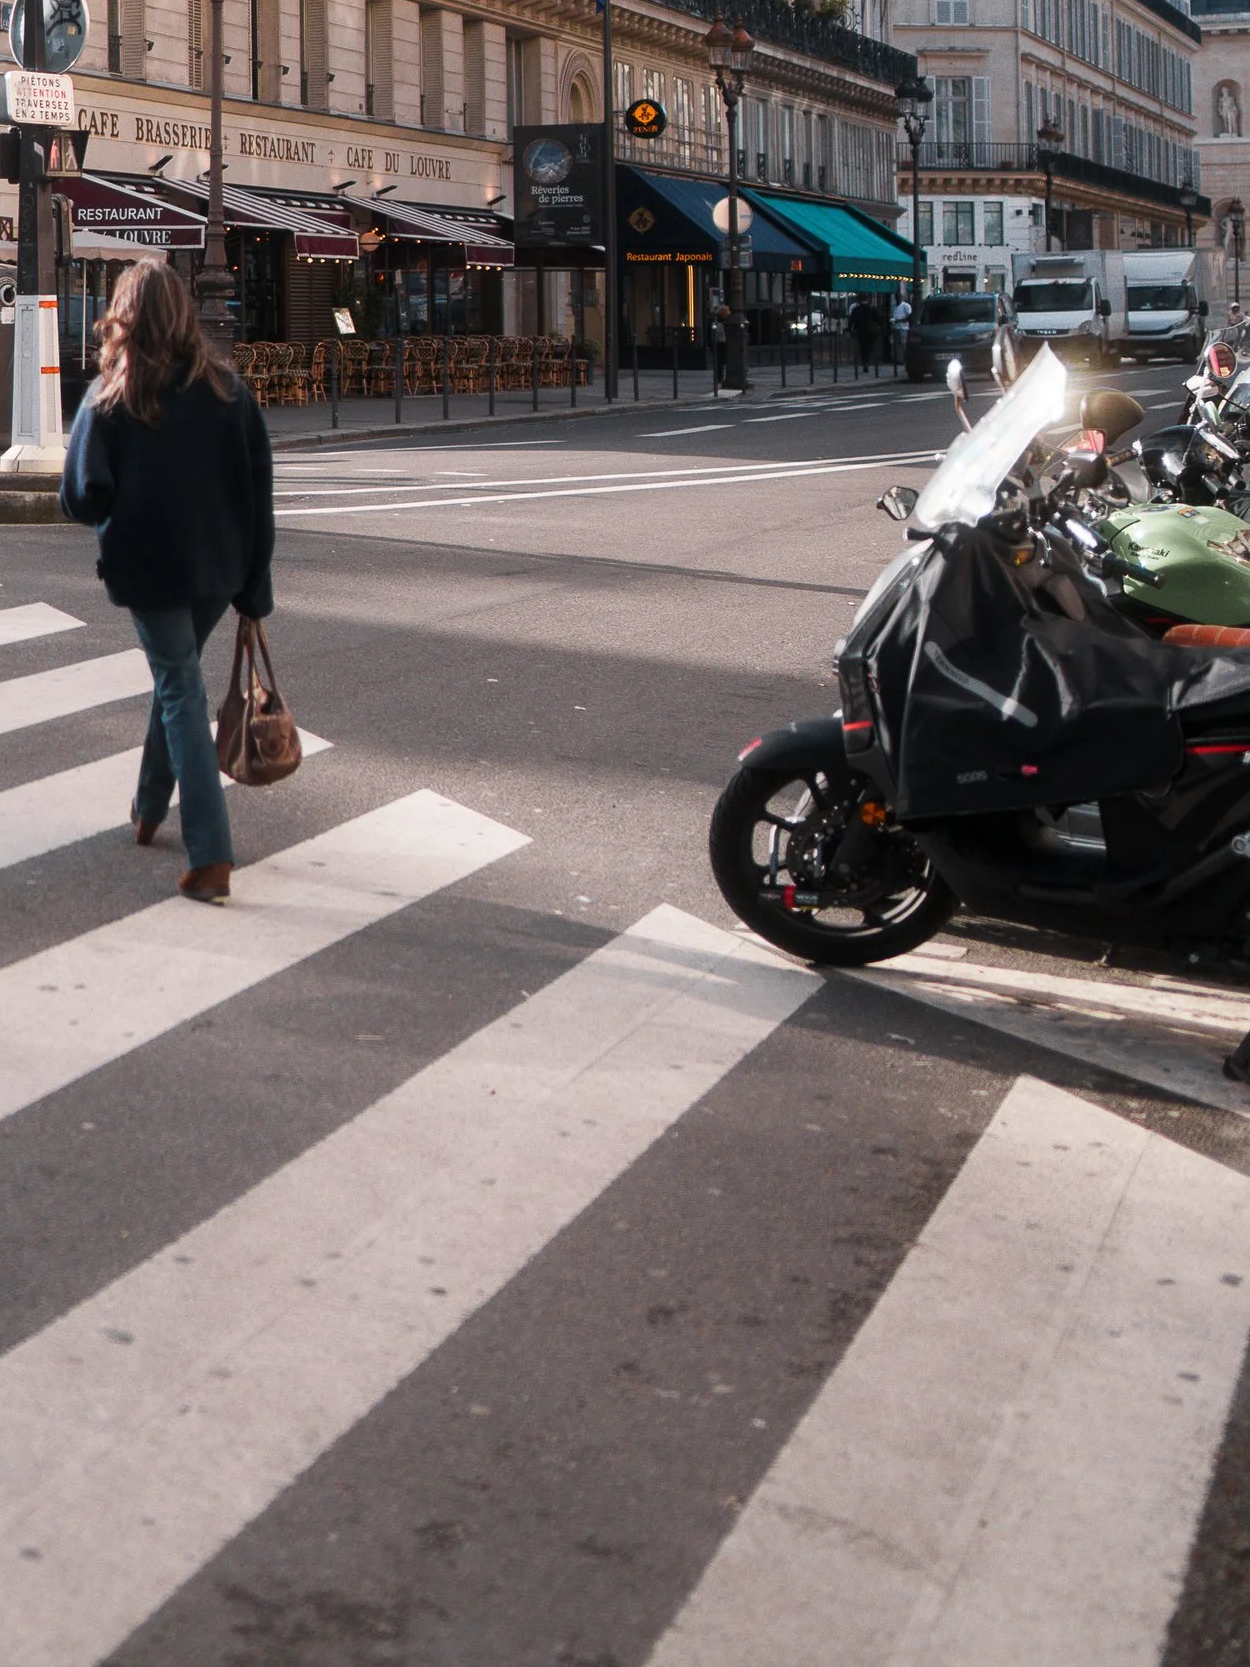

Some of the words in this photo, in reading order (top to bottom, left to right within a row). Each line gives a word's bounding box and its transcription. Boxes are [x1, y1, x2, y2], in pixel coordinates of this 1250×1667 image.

[21, 76, 61, 87] PIÉTONS
[16, 88, 67, 100] ATTENTION
[15, 98, 69, 111] TRAVERSEZ
[15, 110, 27, 119] EN
[30, 110, 36, 119] 2
[39, 110, 70, 122] TEMPS
[78, 108, 120, 138] CAFE
[135, 117, 211, 150] BRASSERIE
[239, 133, 317, 164] RESTAURANT
[346, 146, 374, 170] CAFE
[384, 152, 400, 173] DU
[410, 155, 452, 180] LOUVRE
[531, 185, 570, 195] Rêveries
[538, 194, 550, 203] de
[551, 194, 584, 204] pierres
[77, 207, 164, 222] RESTAURANT
[626, 252, 672, 261] Restaurant
[675, 252, 713, 263] Japonais
[942, 251, 978, 262] redline
[1128, 541, 1170, 558] Kawaki
